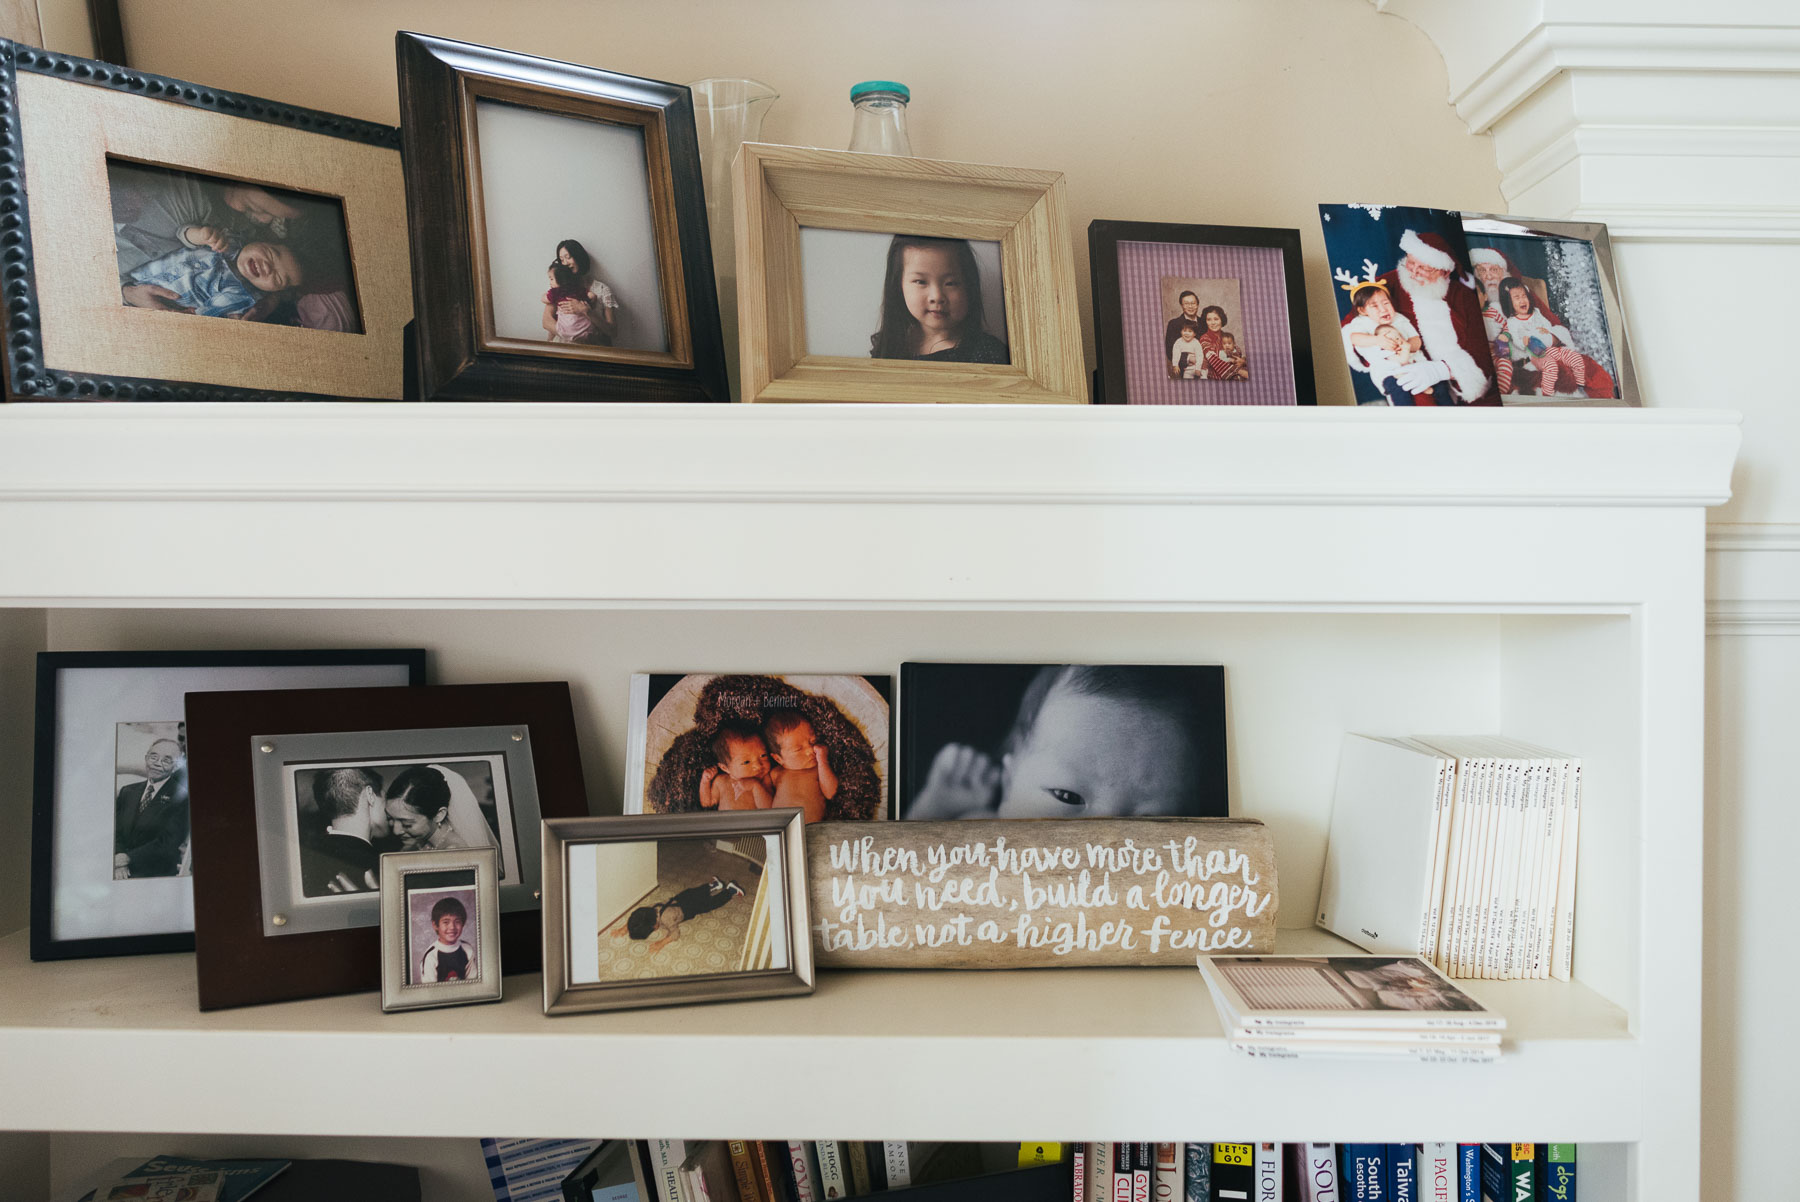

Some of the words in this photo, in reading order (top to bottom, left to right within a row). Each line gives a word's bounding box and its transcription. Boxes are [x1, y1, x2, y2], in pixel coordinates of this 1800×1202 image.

[717, 691, 751, 712] Morgan
[763, 691, 798, 708] Bennett
[829, 835, 926, 877] When
[927, 843, 991, 884] you
[989, 836, 1080, 875] have
[1086, 838, 1163, 875] more
[1162, 836, 1260, 885] than
[915, 866, 1018, 911] need,
[1023, 869, 1118, 911] build
[1126, 885, 1150, 911] a
[1150, 869, 1271, 928] longer
[812, 912, 914, 952] table,
[915, 913, 974, 948] not
[977, 919, 1008, 944] a
[1011, 911, 1138, 955] higher
[1140, 915, 1254, 953] fence.
[828, 1152, 838, 1180] HOGG
[897, 1144, 906, 1174] ANNE
[1218, 1145, 1248, 1154] LET'S
[1224, 1154, 1242, 1164] GO
[1074, 1156, 1083, 1202] LABRADO
[1117, 1177, 1130, 1202] CLI
[1356, 1157, 1366, 1198] Lesotho
[1368, 1157, 1382, 1200] South
[1464, 1148, 1475, 1196] Washington's
[1548, 1165, 1574, 1200] dogs
